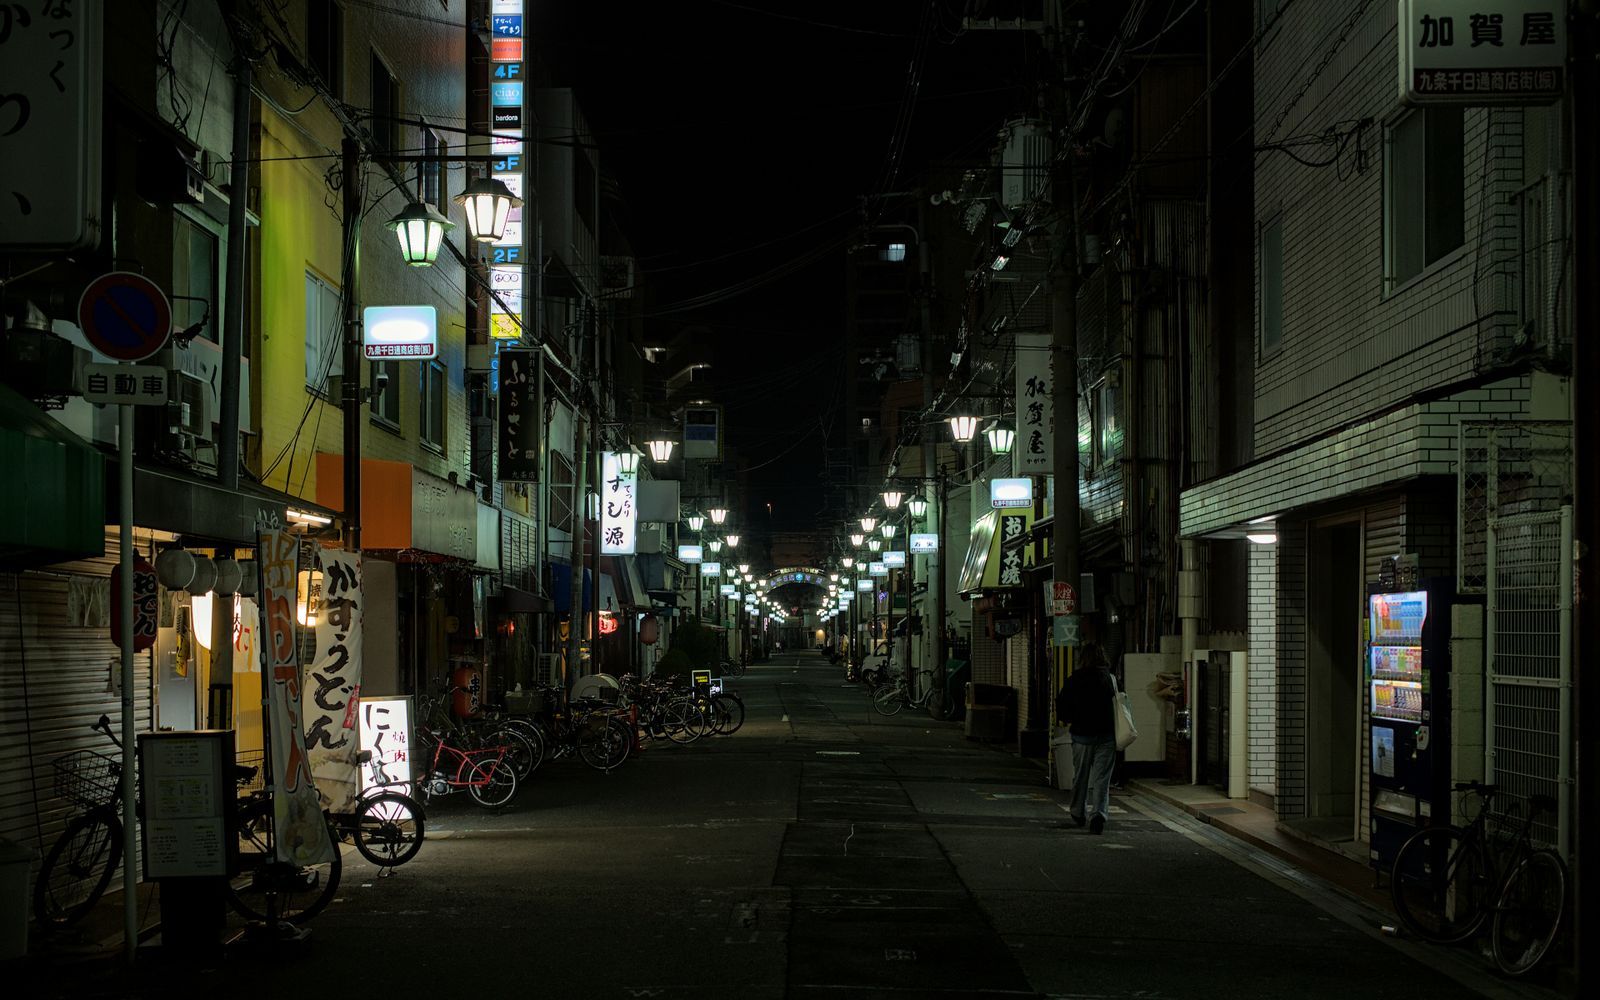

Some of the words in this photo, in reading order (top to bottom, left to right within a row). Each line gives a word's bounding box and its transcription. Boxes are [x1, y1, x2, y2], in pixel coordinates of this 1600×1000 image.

[499, 25, 520, 34] てまり
[1419, 13, 1556, 47] 加賀屋
[494, 64, 520, 78] 4F
[494, 248, 519, 263] 2F
[88, 373, 163, 396] 自動車
[1025, 375, 1045, 454] 加賀屋
[605, 475, 624, 546] すし源
[1060, 622, 1080, 641] 文
[305, 560, 358, 750] かすうどん
